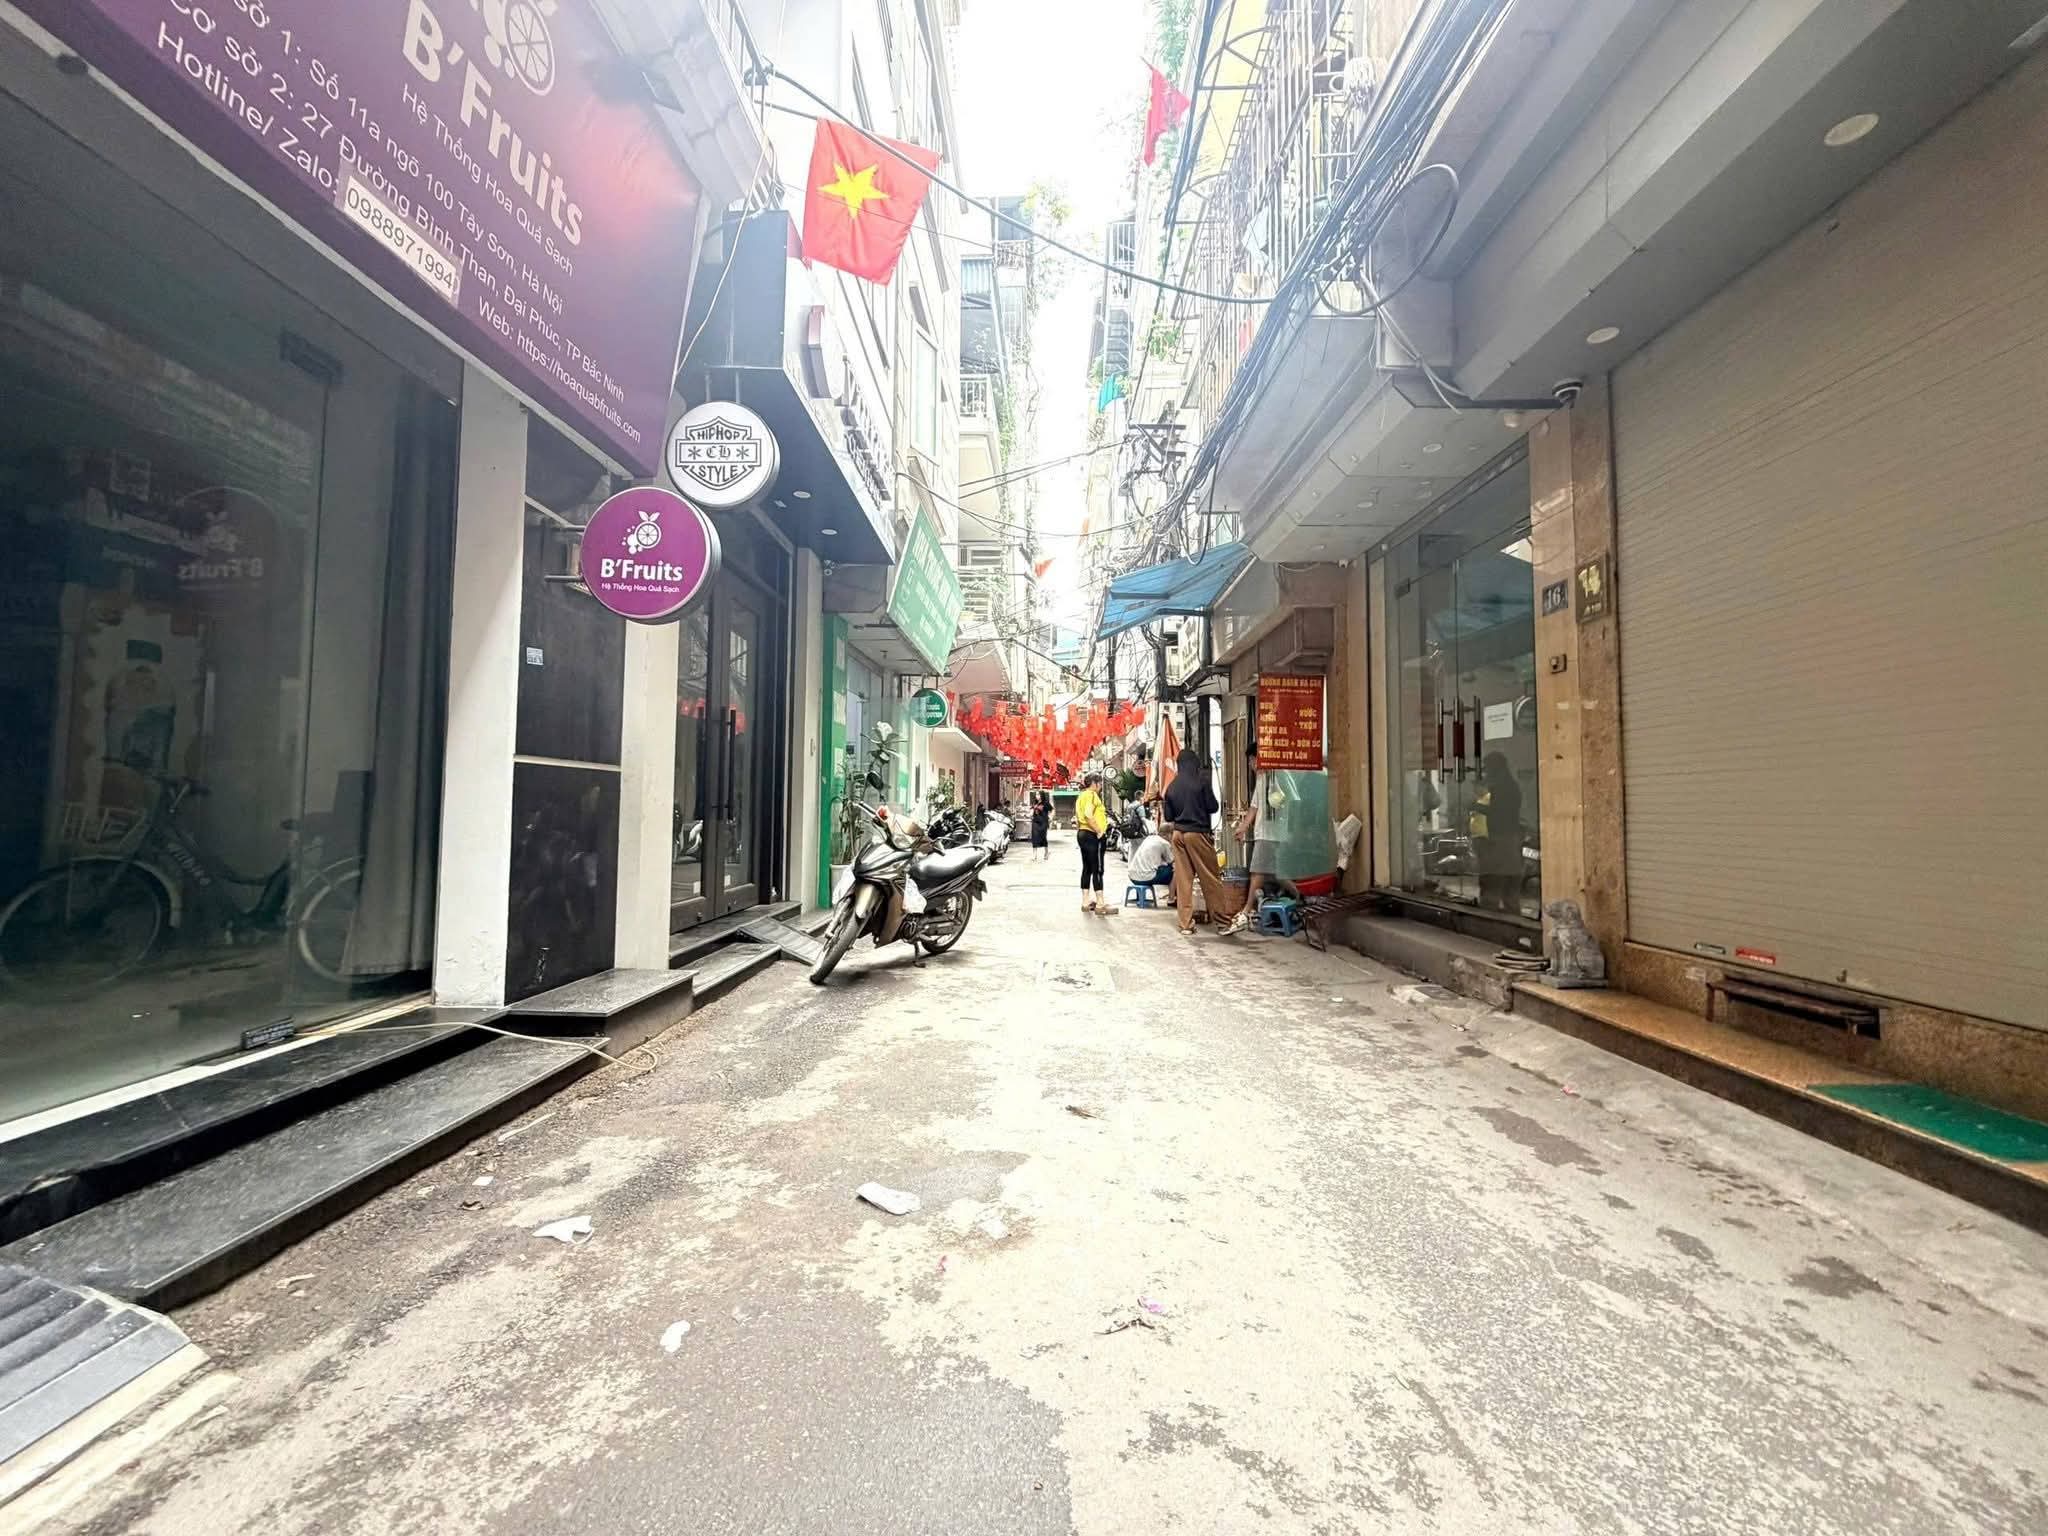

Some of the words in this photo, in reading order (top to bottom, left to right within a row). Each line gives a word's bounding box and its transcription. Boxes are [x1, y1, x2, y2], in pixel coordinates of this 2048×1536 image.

[158, 21, 274, 135] Hotline/
[278, 127, 339, 195] Zalo:
[347, 187, 454, 290] 0988971994
[281, 30, 302, 64] 1:
[309, 59, 339, 100] Số
[349, 97, 381, 142] 11a
[386, 136, 420, 177] ngõ
[426, 174, 454, 210] 100
[458, 201, 485, 242] Tây
[487, 232, 517, 276] Sơn,
[522, 264, 540, 294] Hà
[543, 284, 563, 315] Nội
[402, 0, 583, 246] B'Fruits
[402, 83, 428, 125] Hệ
[433, 114, 482, 184] Thống
[485, 173, 513, 214] Hoa
[516, 207, 543, 245] Quả
[544, 237, 574, 277] Sạch
[225, 36, 263, 76] sở
[270, 72, 295, 110] 2:
[301, 102, 334, 138] 27
[339, 135, 411, 217] Đường
[415, 204, 455, 254] Bình
[460, 243, 499, 297] Than,
[503, 284, 527, 317] Đại
[529, 307, 562, 352] Phúc,
[565, 338, 581, 360] TP
[582, 355, 602, 383] Bắc
[603, 373, 625, 404] Ninh
[479, 296, 514, 340] Web:
[517, 329, 642, 444] https://hoaquabfruits.com
[697, 425, 741, 441] HIPHOP
[698, 464, 739, 483] STYLE
[600, 558, 684, 582] B'Fruits
[613, 583, 633, 593] Thống
